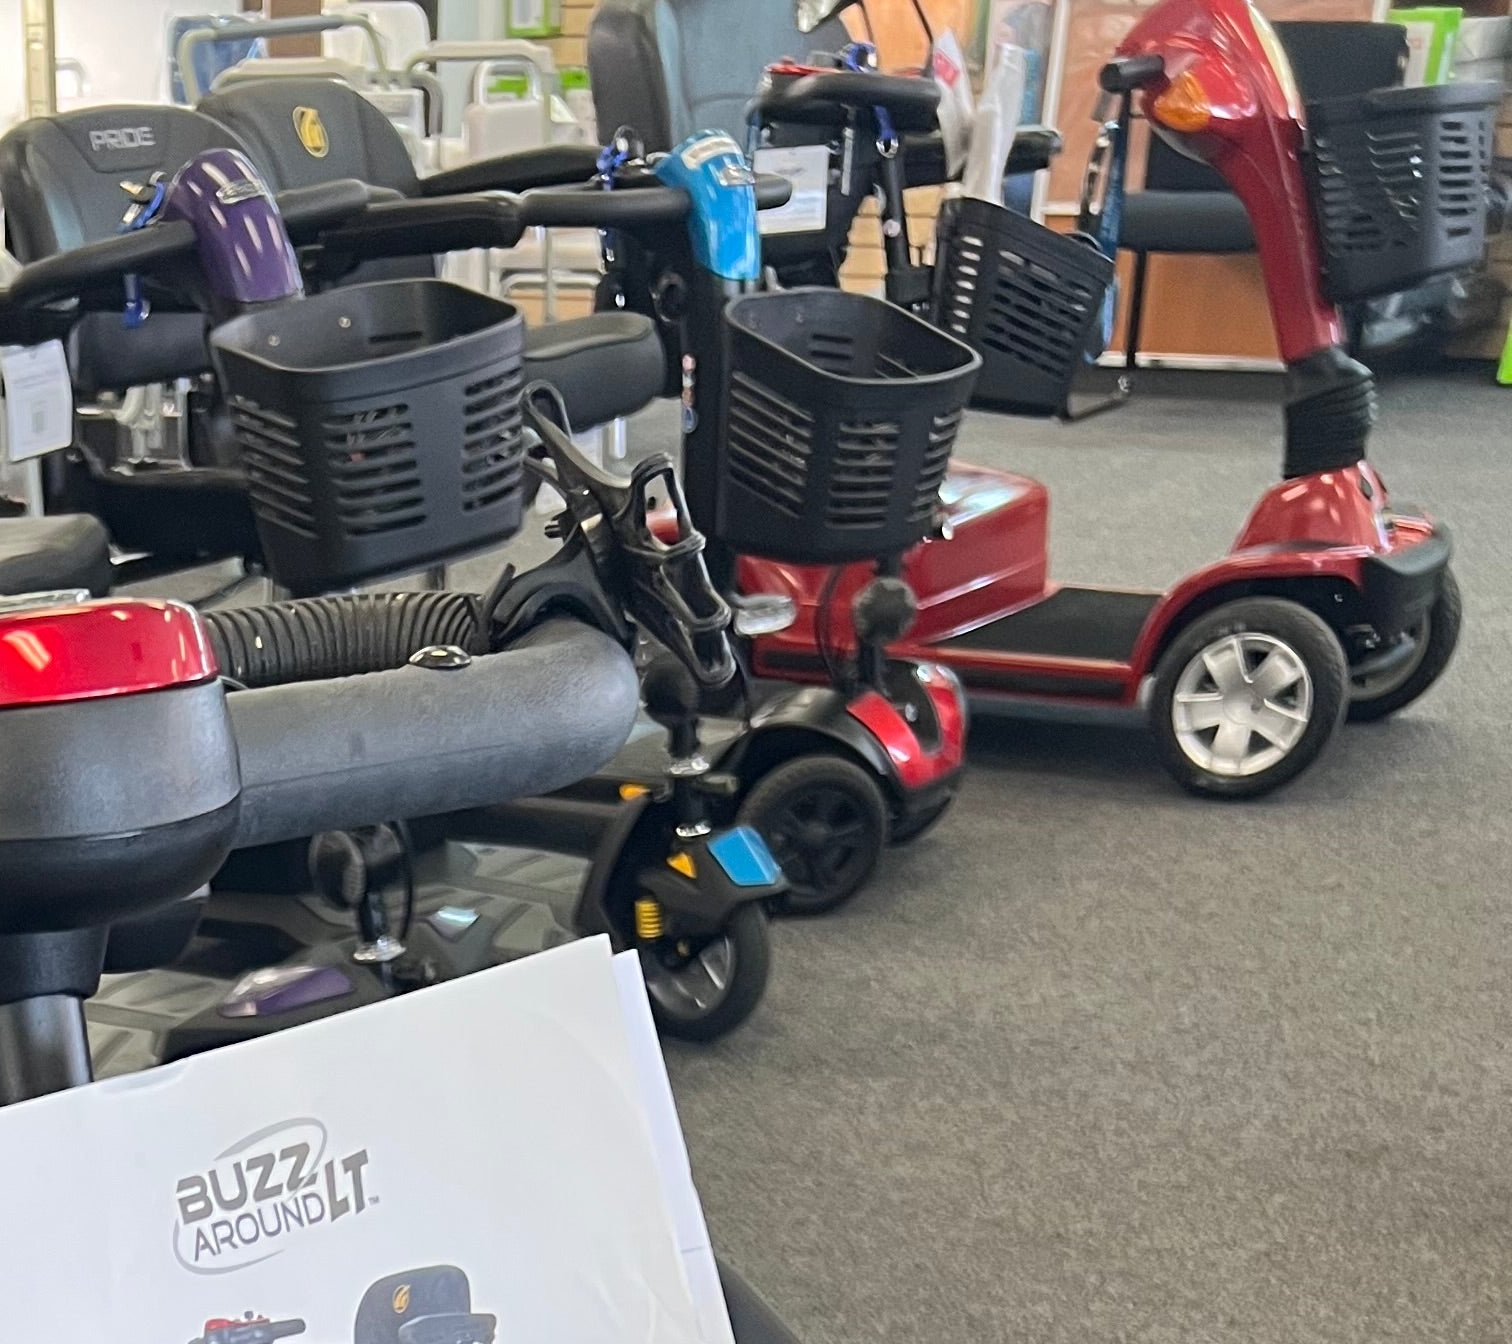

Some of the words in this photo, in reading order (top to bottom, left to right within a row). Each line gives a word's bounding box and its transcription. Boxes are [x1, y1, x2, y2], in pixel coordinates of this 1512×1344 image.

[88, 126, 157, 152] PRIDE
[176, 1141, 318, 1225] BUZZ
[194, 1192, 325, 1262] AROUND
